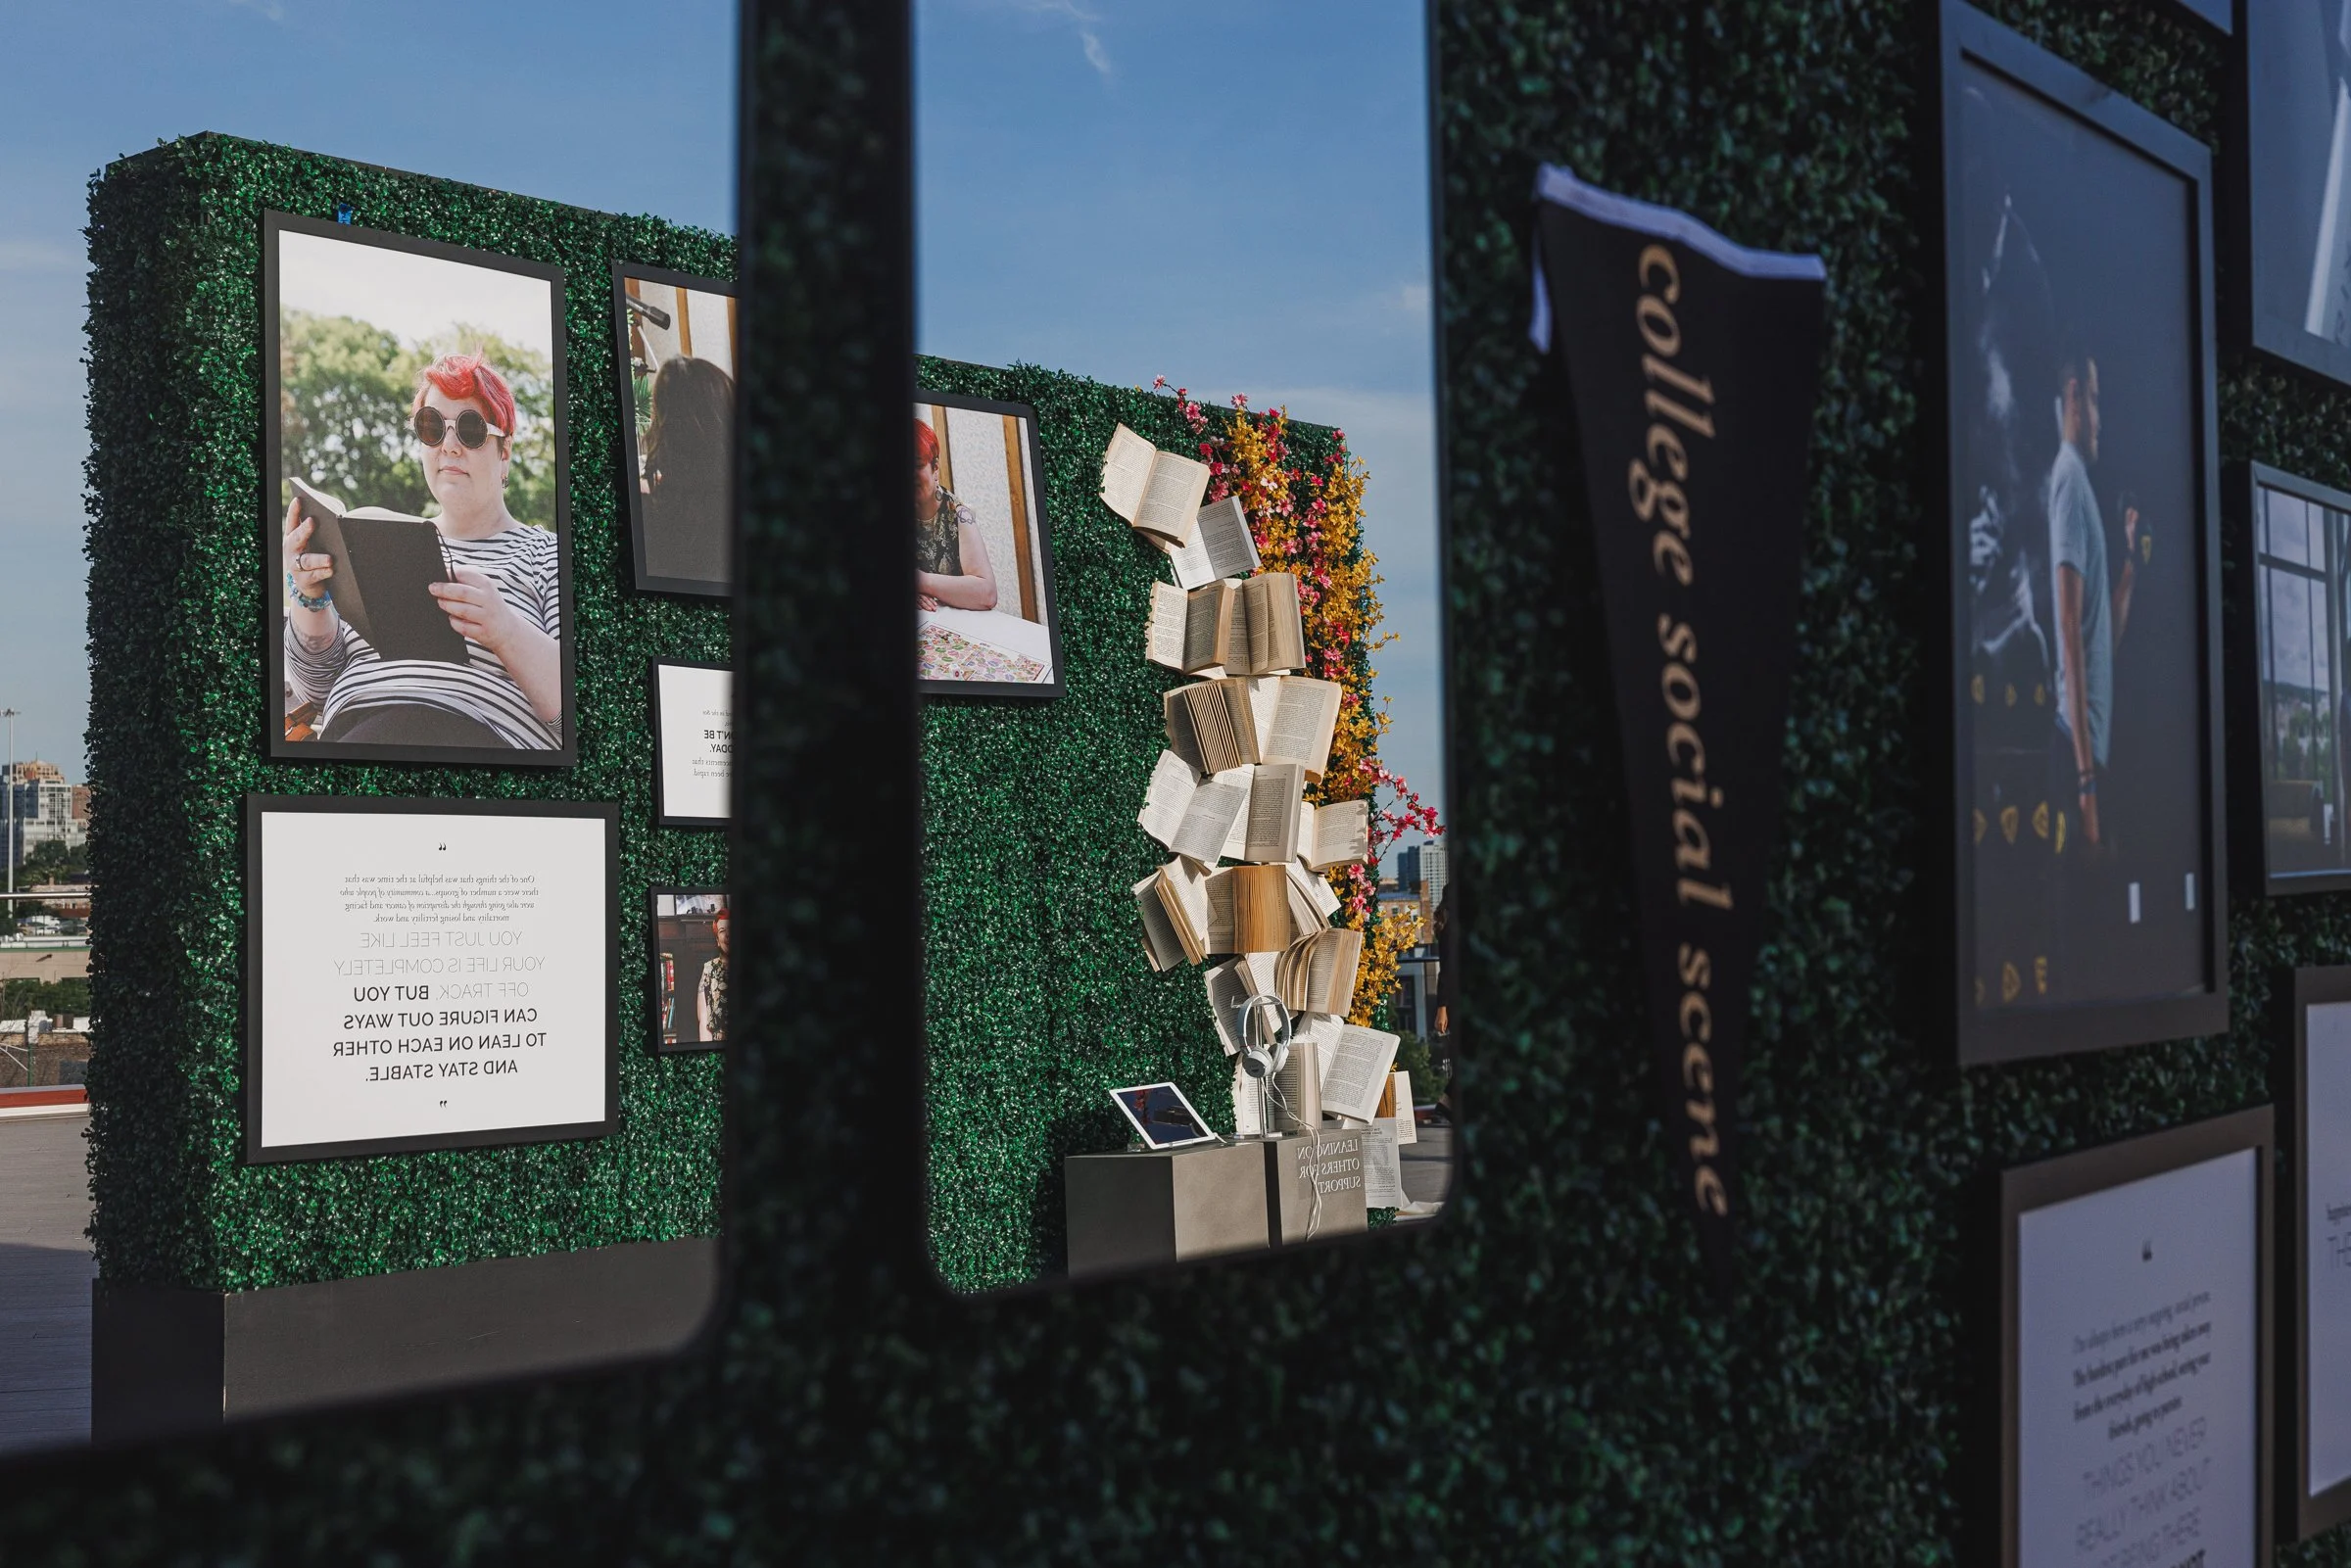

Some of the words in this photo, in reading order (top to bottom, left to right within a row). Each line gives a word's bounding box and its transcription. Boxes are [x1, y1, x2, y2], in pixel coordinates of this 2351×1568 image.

[1629, 245, 1715, 586] college
[1658, 613, 1734, 909] social
[1678, 942, 1727, 1215] scene
